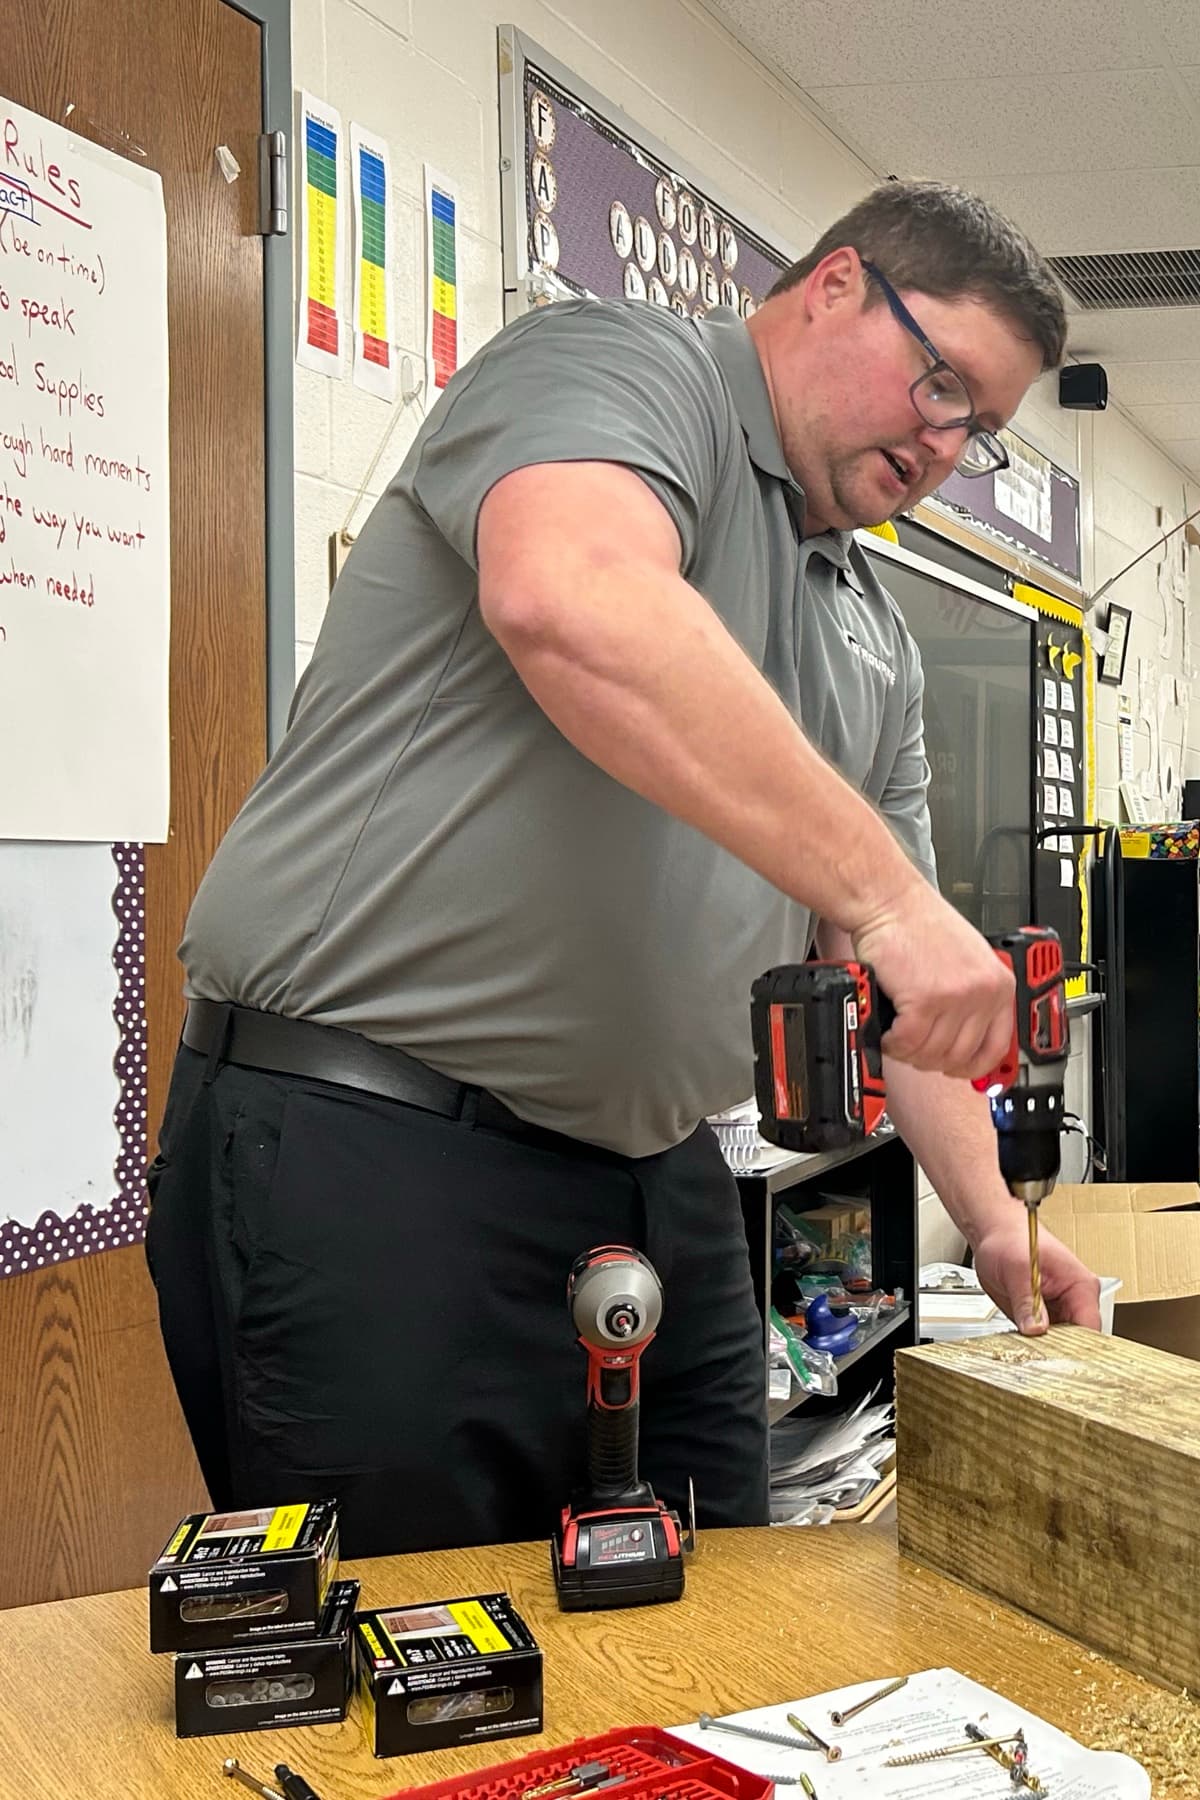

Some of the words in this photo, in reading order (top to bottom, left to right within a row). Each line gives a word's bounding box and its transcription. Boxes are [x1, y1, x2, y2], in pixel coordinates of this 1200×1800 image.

[4, 119, 81, 208] Rules
[615, 213, 751, 321] AUDIENC
[21, 296, 76, 338] speak
[34, 362, 105, 418] Supplies
[40, 426, 75, 472] hard
[85, 454, 151, 492] moments
[32, 506, 67, 550] way
[107, 520, 146, 550] want
[46, 571, 95, 609] needed
